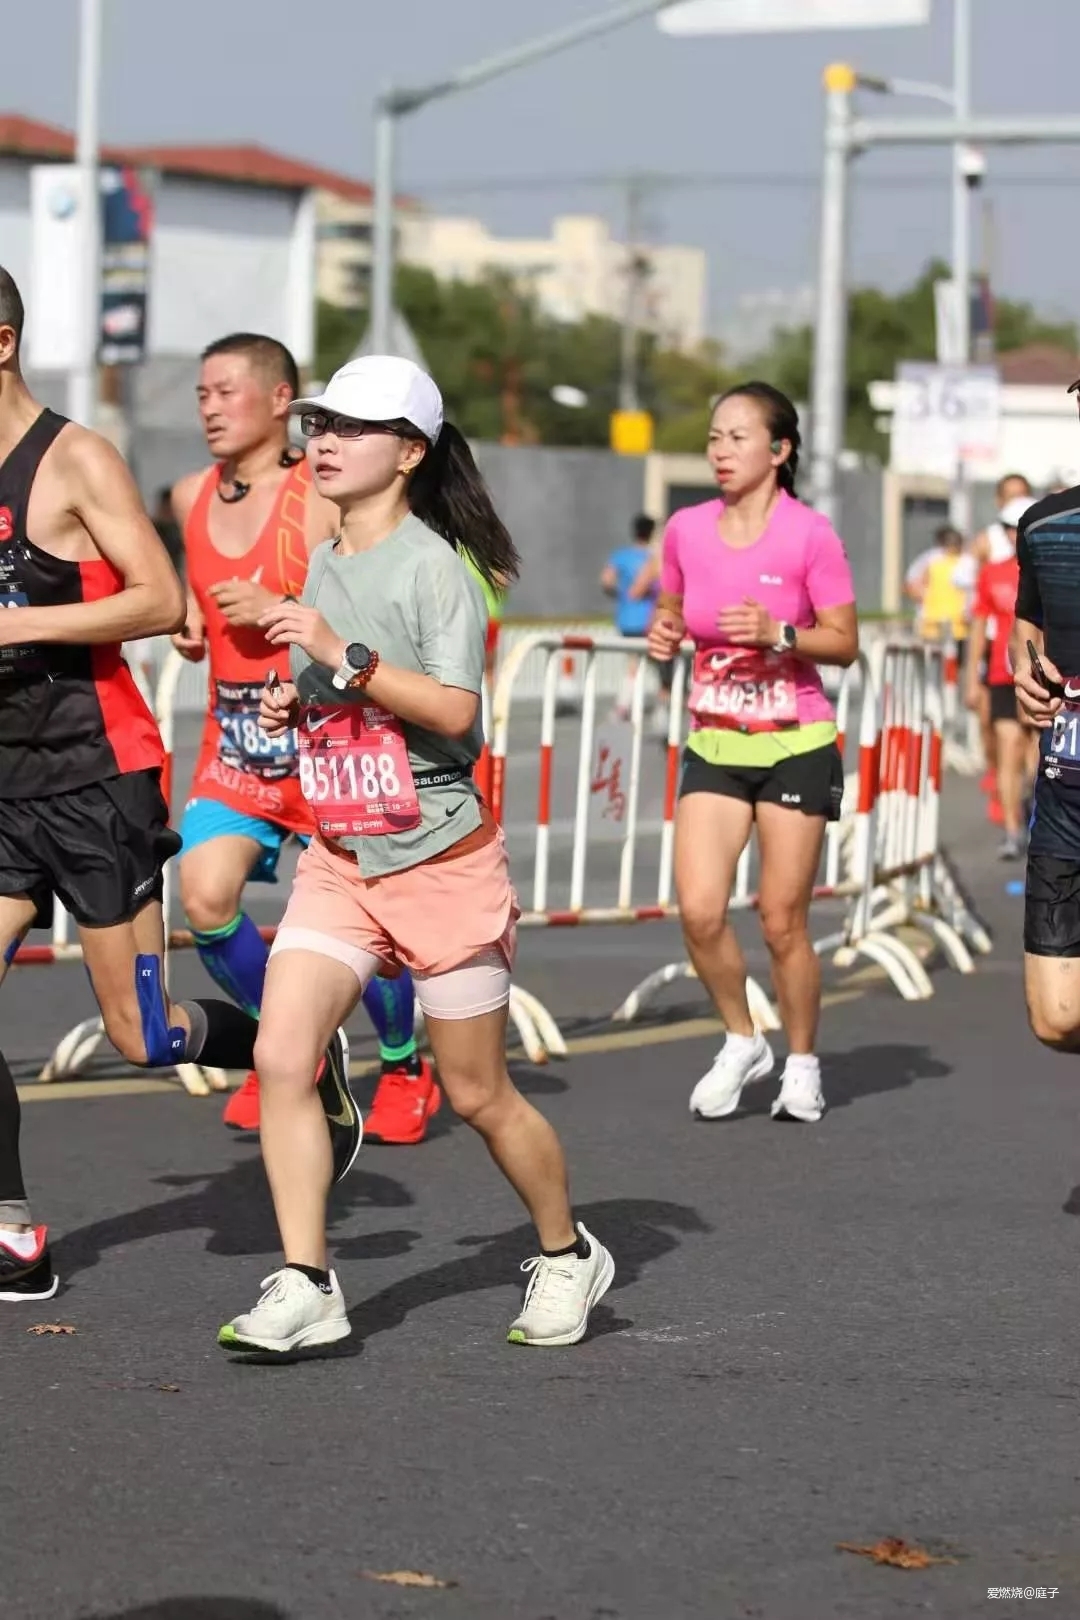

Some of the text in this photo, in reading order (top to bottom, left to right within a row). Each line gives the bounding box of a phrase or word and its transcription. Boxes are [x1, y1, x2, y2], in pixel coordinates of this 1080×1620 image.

[696, 679, 788, 715] A50315
[300, 753, 400, 800] B51188
[414, 772, 461, 786] salomon
[142, 969, 152, 977] KT
[172, 1040, 182, 1048] KT
